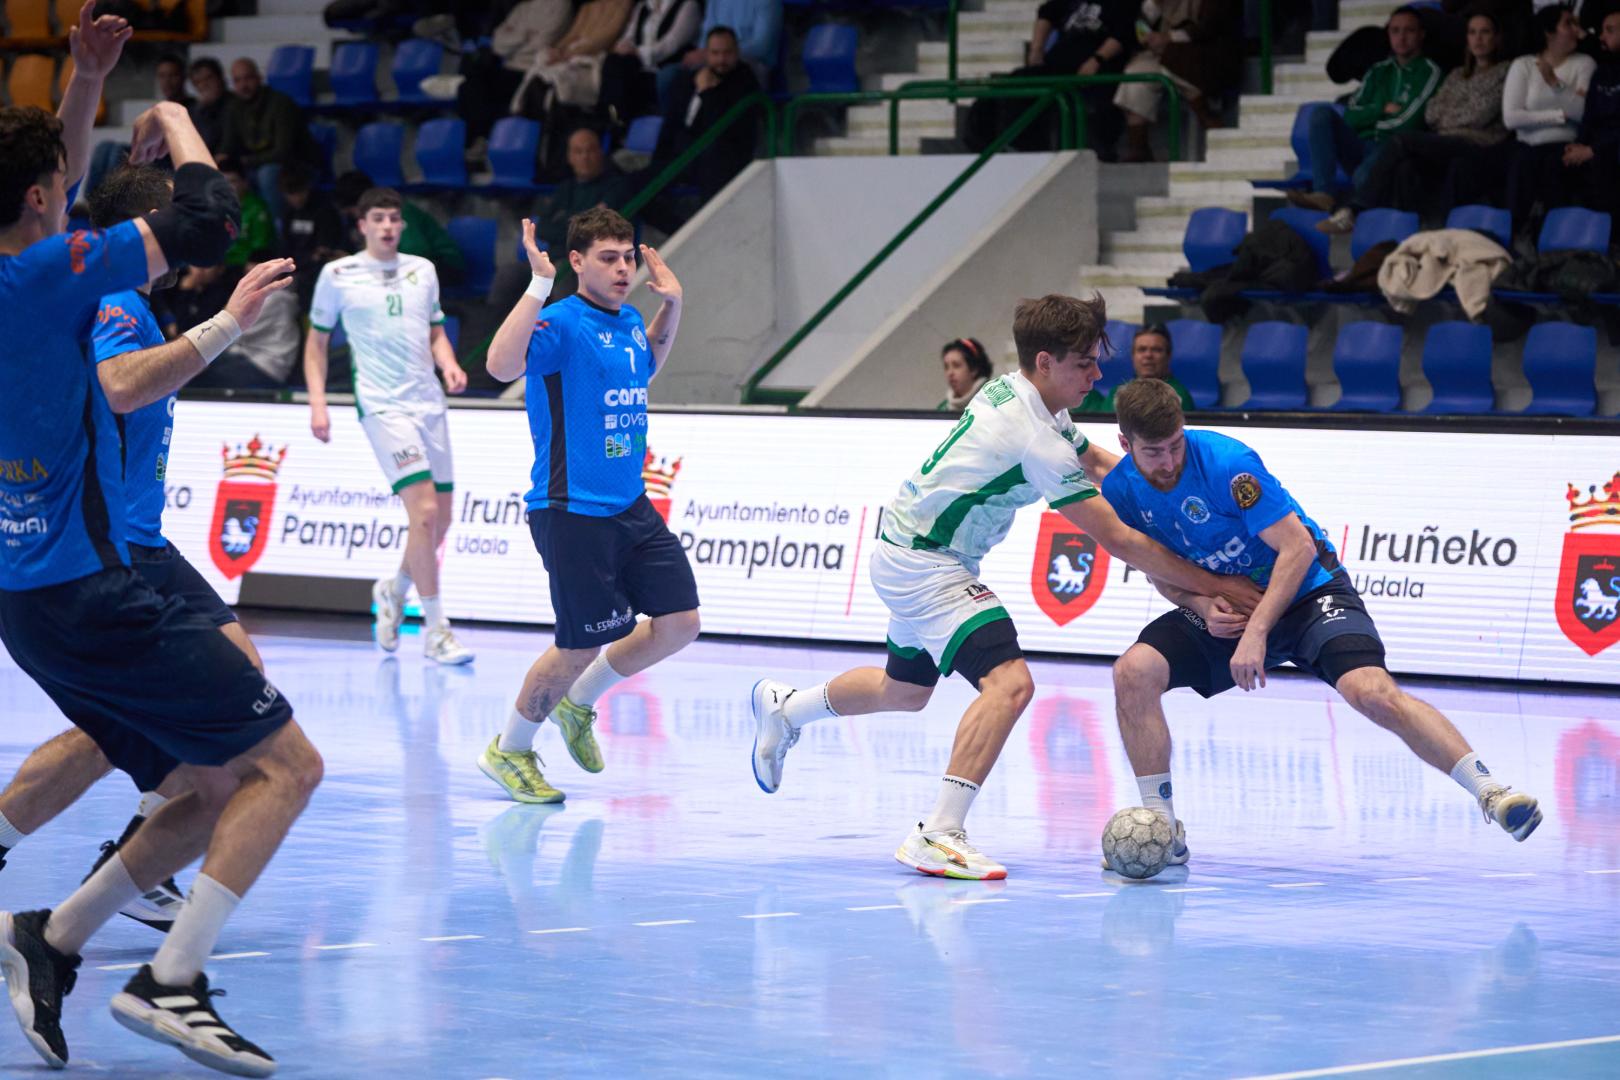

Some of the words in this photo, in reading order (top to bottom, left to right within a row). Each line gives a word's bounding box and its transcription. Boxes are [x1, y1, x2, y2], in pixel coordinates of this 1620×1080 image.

[385, 293, 403, 317] 21
[624, 346, 637, 374] 7
[287, 484, 402, 509] Ayuntamien
[684, 499, 820, 526] Ayuntamiento
[825, 504, 851, 525] de
[680, 531, 845, 579] Pamplona
[1359, 524, 1518, 567] Iruñeko
[1355, 574, 1425, 598] Udala
